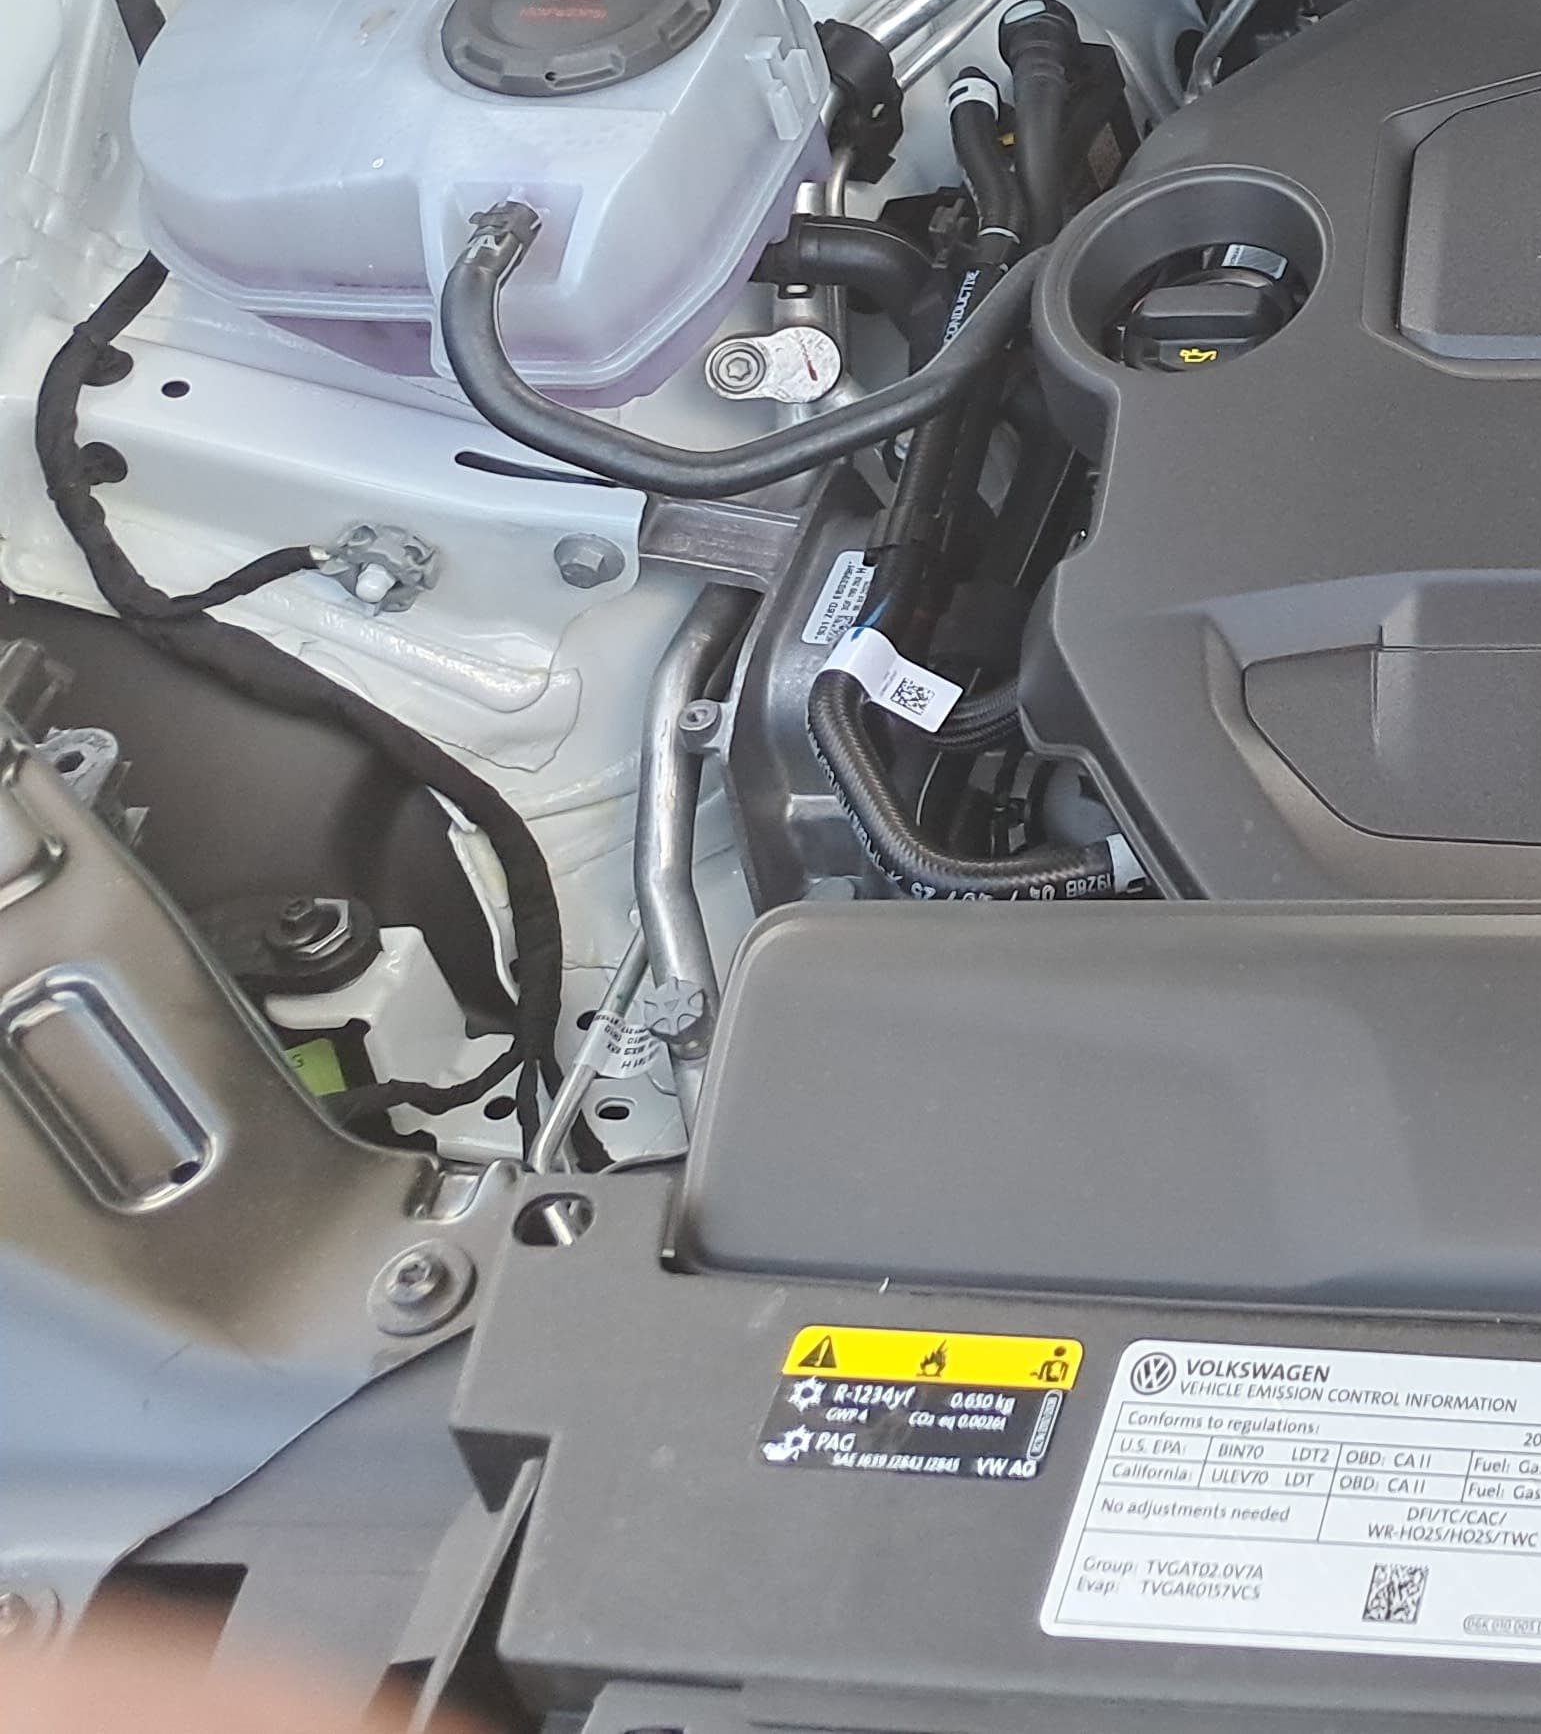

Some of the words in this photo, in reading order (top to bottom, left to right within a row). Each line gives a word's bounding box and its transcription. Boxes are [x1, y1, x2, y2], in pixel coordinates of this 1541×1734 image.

[1187, 1359, 1331, 1383] VOLKSWAGEN
[833, 1384, 917, 1410] R-1234yf
[995, 1396, 1016, 1415] kg
[1180, 1381, 1242, 1397] VEHICLE
[1248, 1384, 1323, 1401] EMISSION
[1328, 1388, 1400, 1406] CONTROL
[1405, 1392, 1518, 1412] INFORMATION
[1128, 1410, 1202, 1429] Conforms
[1207, 1414, 1222, 1430] to
[1227, 1417, 1320, 1435] regulations:
[815, 1433, 856, 1452] PAG
[976, 1457, 1008, 1476] VW
[1008, 1459, 1039, 1477] AG
[1152, 1439, 1186, 1456] EPA:
[1218, 1443, 1264, 1459] BIN70
[1291, 1446, 1330, 1463] LDT2
[1346, 1449, 1385, 1467] OBD:
[1393, 1451, 1416, 1467] CA
[1473, 1456, 1510, 1473] Fuel:
[1112, 1462, 1192, 1481] California:
[1212, 1469, 1268, 1485] ULEV70
[1285, 1472, 1315, 1487] LDT
[1339, 1474, 1379, 1491] OBD:
[1387, 1476, 1409, 1493] CA
[1468, 1482, 1505, 1498] Fuel:
[1101, 1497, 1124, 1513] No
[1127, 1500, 1226, 1519] adjustments
[1231, 1505, 1291, 1522] needed
[1407, 1506, 1508, 1526] DFI/TC/CAC/
